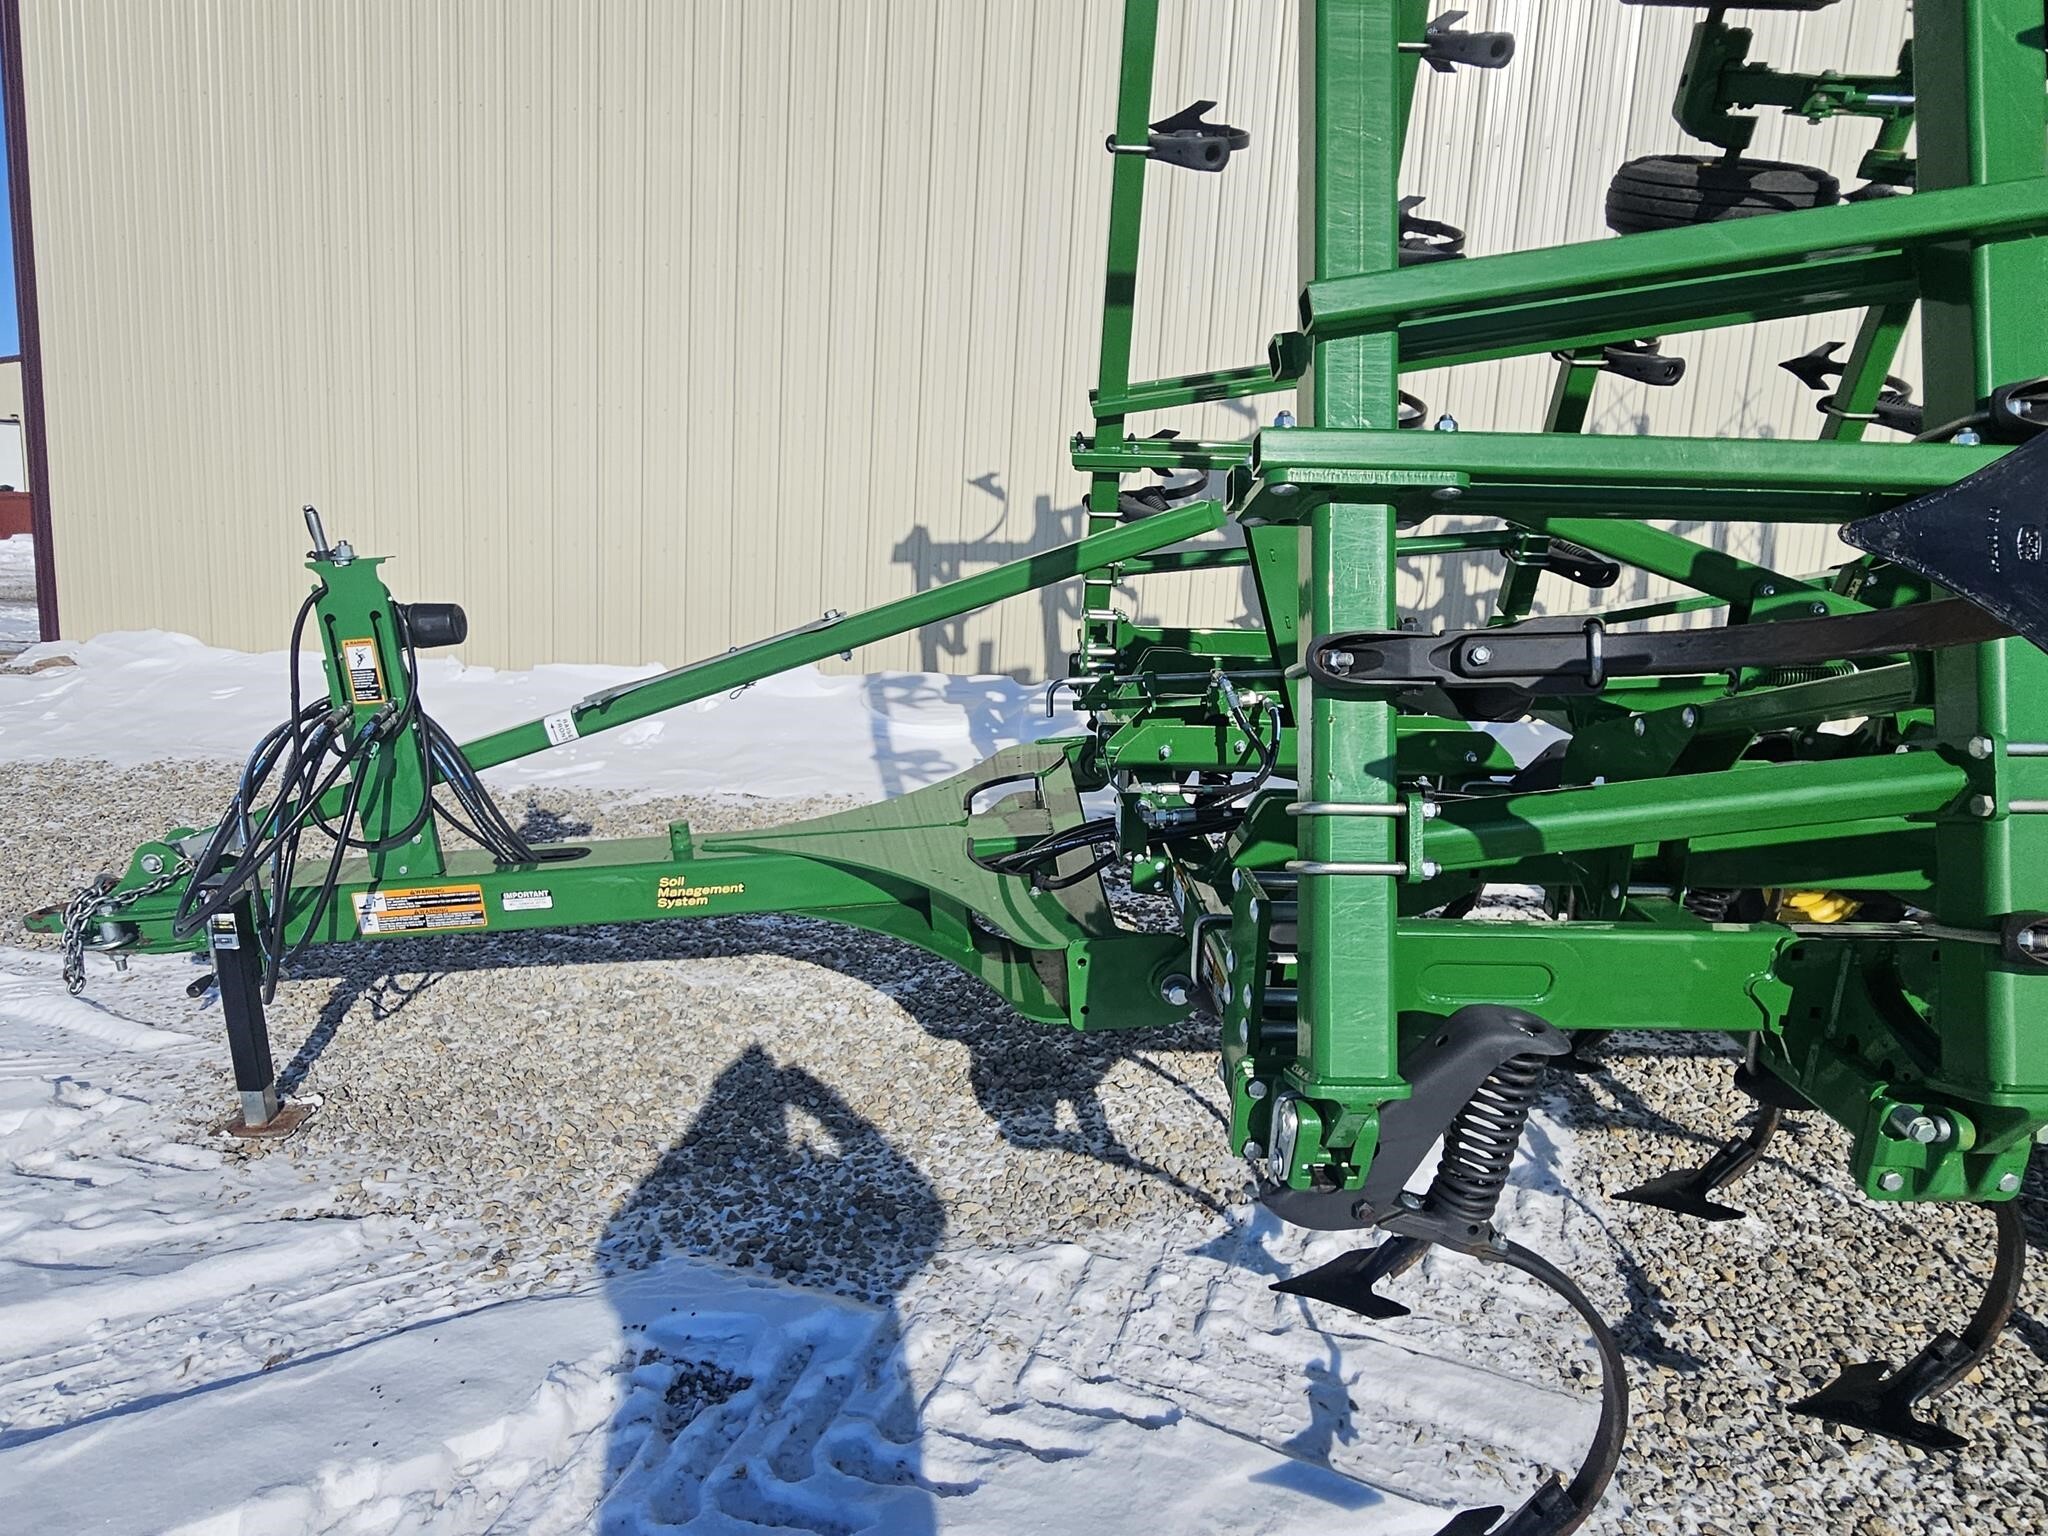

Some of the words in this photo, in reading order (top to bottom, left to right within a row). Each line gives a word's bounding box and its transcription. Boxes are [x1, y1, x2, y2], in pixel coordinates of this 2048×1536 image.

[556, 719, 569, 740] FRONT
[562, 719, 573, 738] RAISE
[659, 876, 685, 887] Soil
[503, 890, 549, 898] IMPORTANT
[658, 883, 745, 898] Management
[657, 897, 708, 909] System
